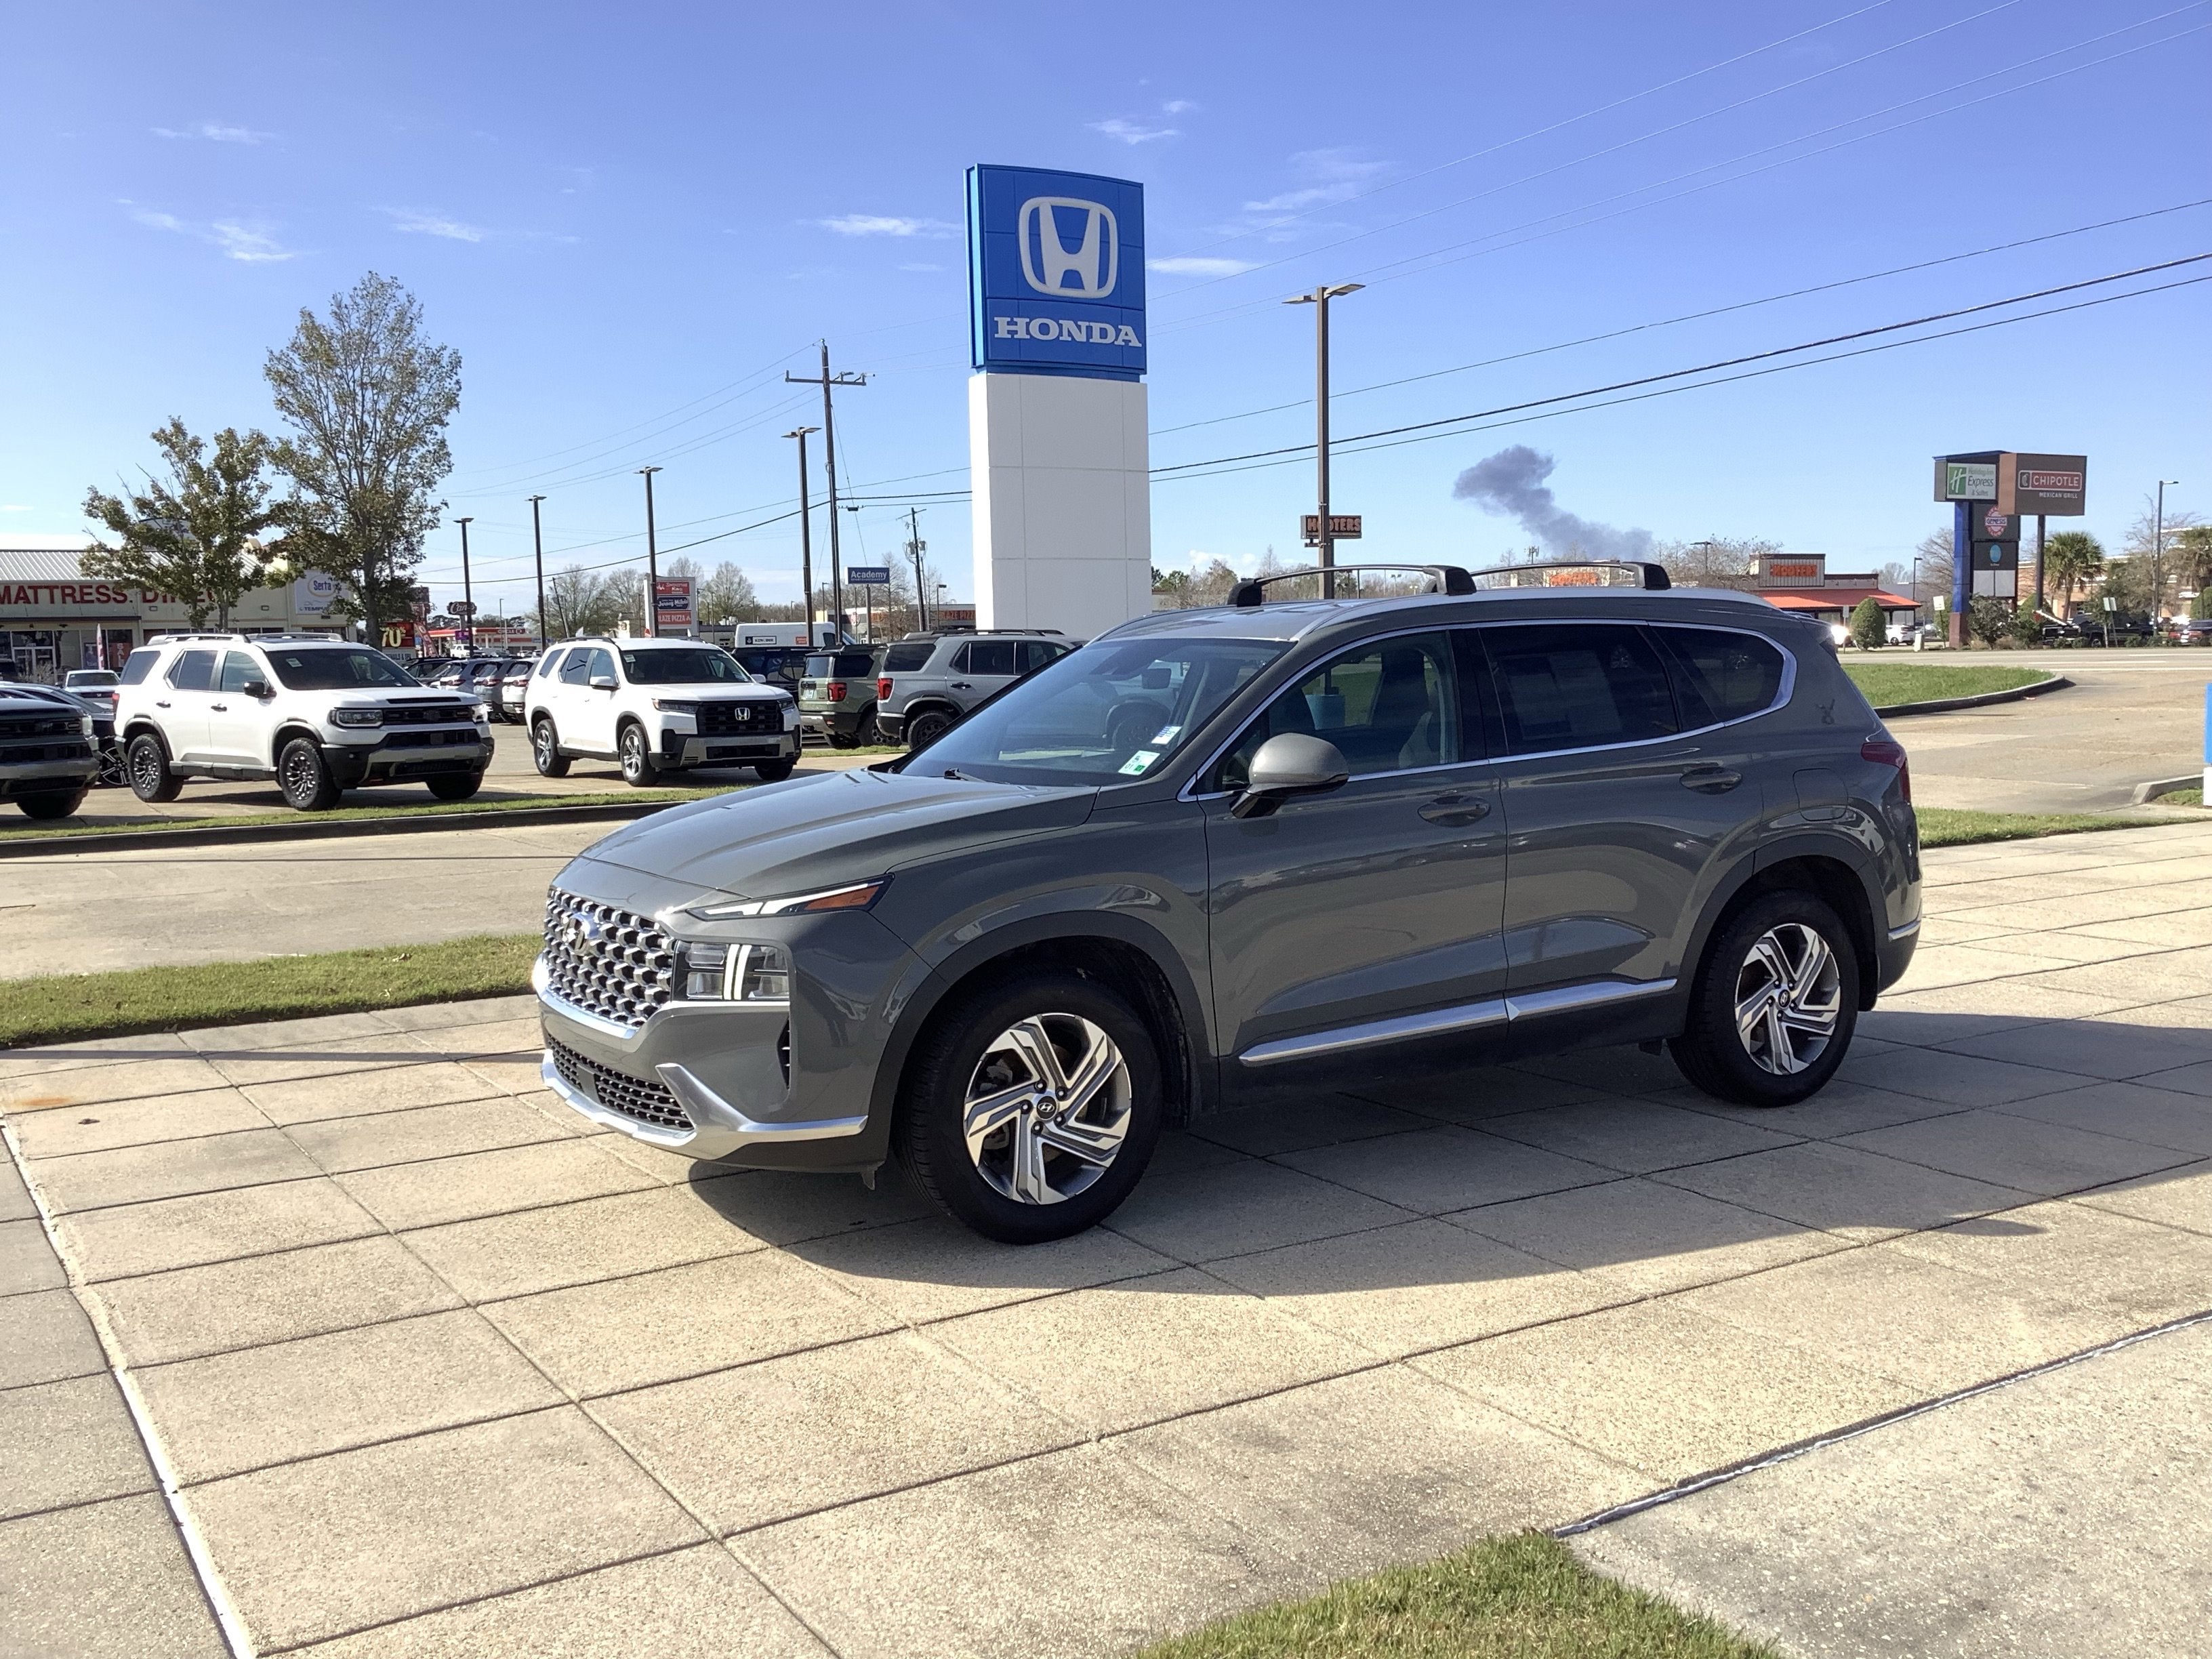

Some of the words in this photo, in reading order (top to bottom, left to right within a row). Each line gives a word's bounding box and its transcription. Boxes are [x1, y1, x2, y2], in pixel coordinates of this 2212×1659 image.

[994, 316, 1143, 348] HONDA
[1967, 475, 1994, 488] Express
[2033, 475, 2079, 487] CHIPOTLE
[851, 571, 887, 580] Academy
[313, 580, 331, 591] Serta
